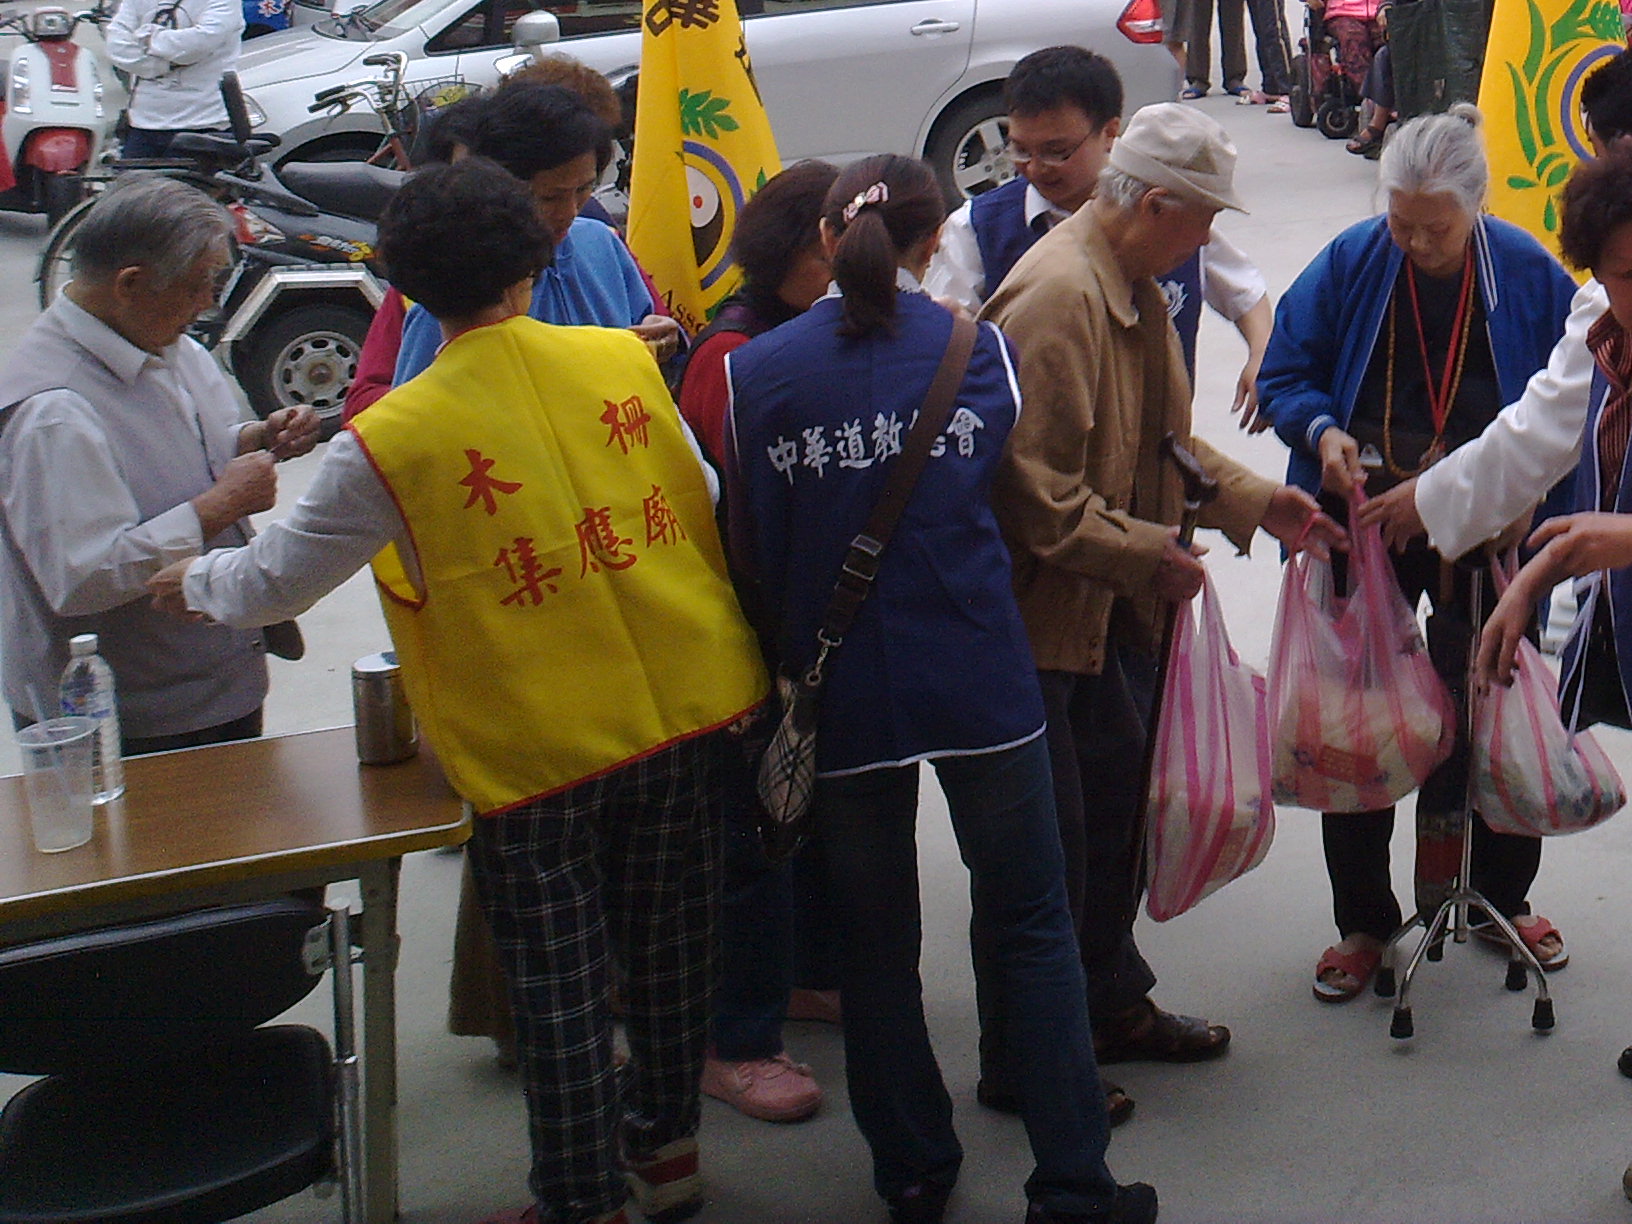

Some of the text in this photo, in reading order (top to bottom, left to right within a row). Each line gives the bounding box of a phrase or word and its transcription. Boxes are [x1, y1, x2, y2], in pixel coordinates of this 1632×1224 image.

[766, 405, 986, 486] 中華道教會
[492, 483, 688, 608] 集應廟
